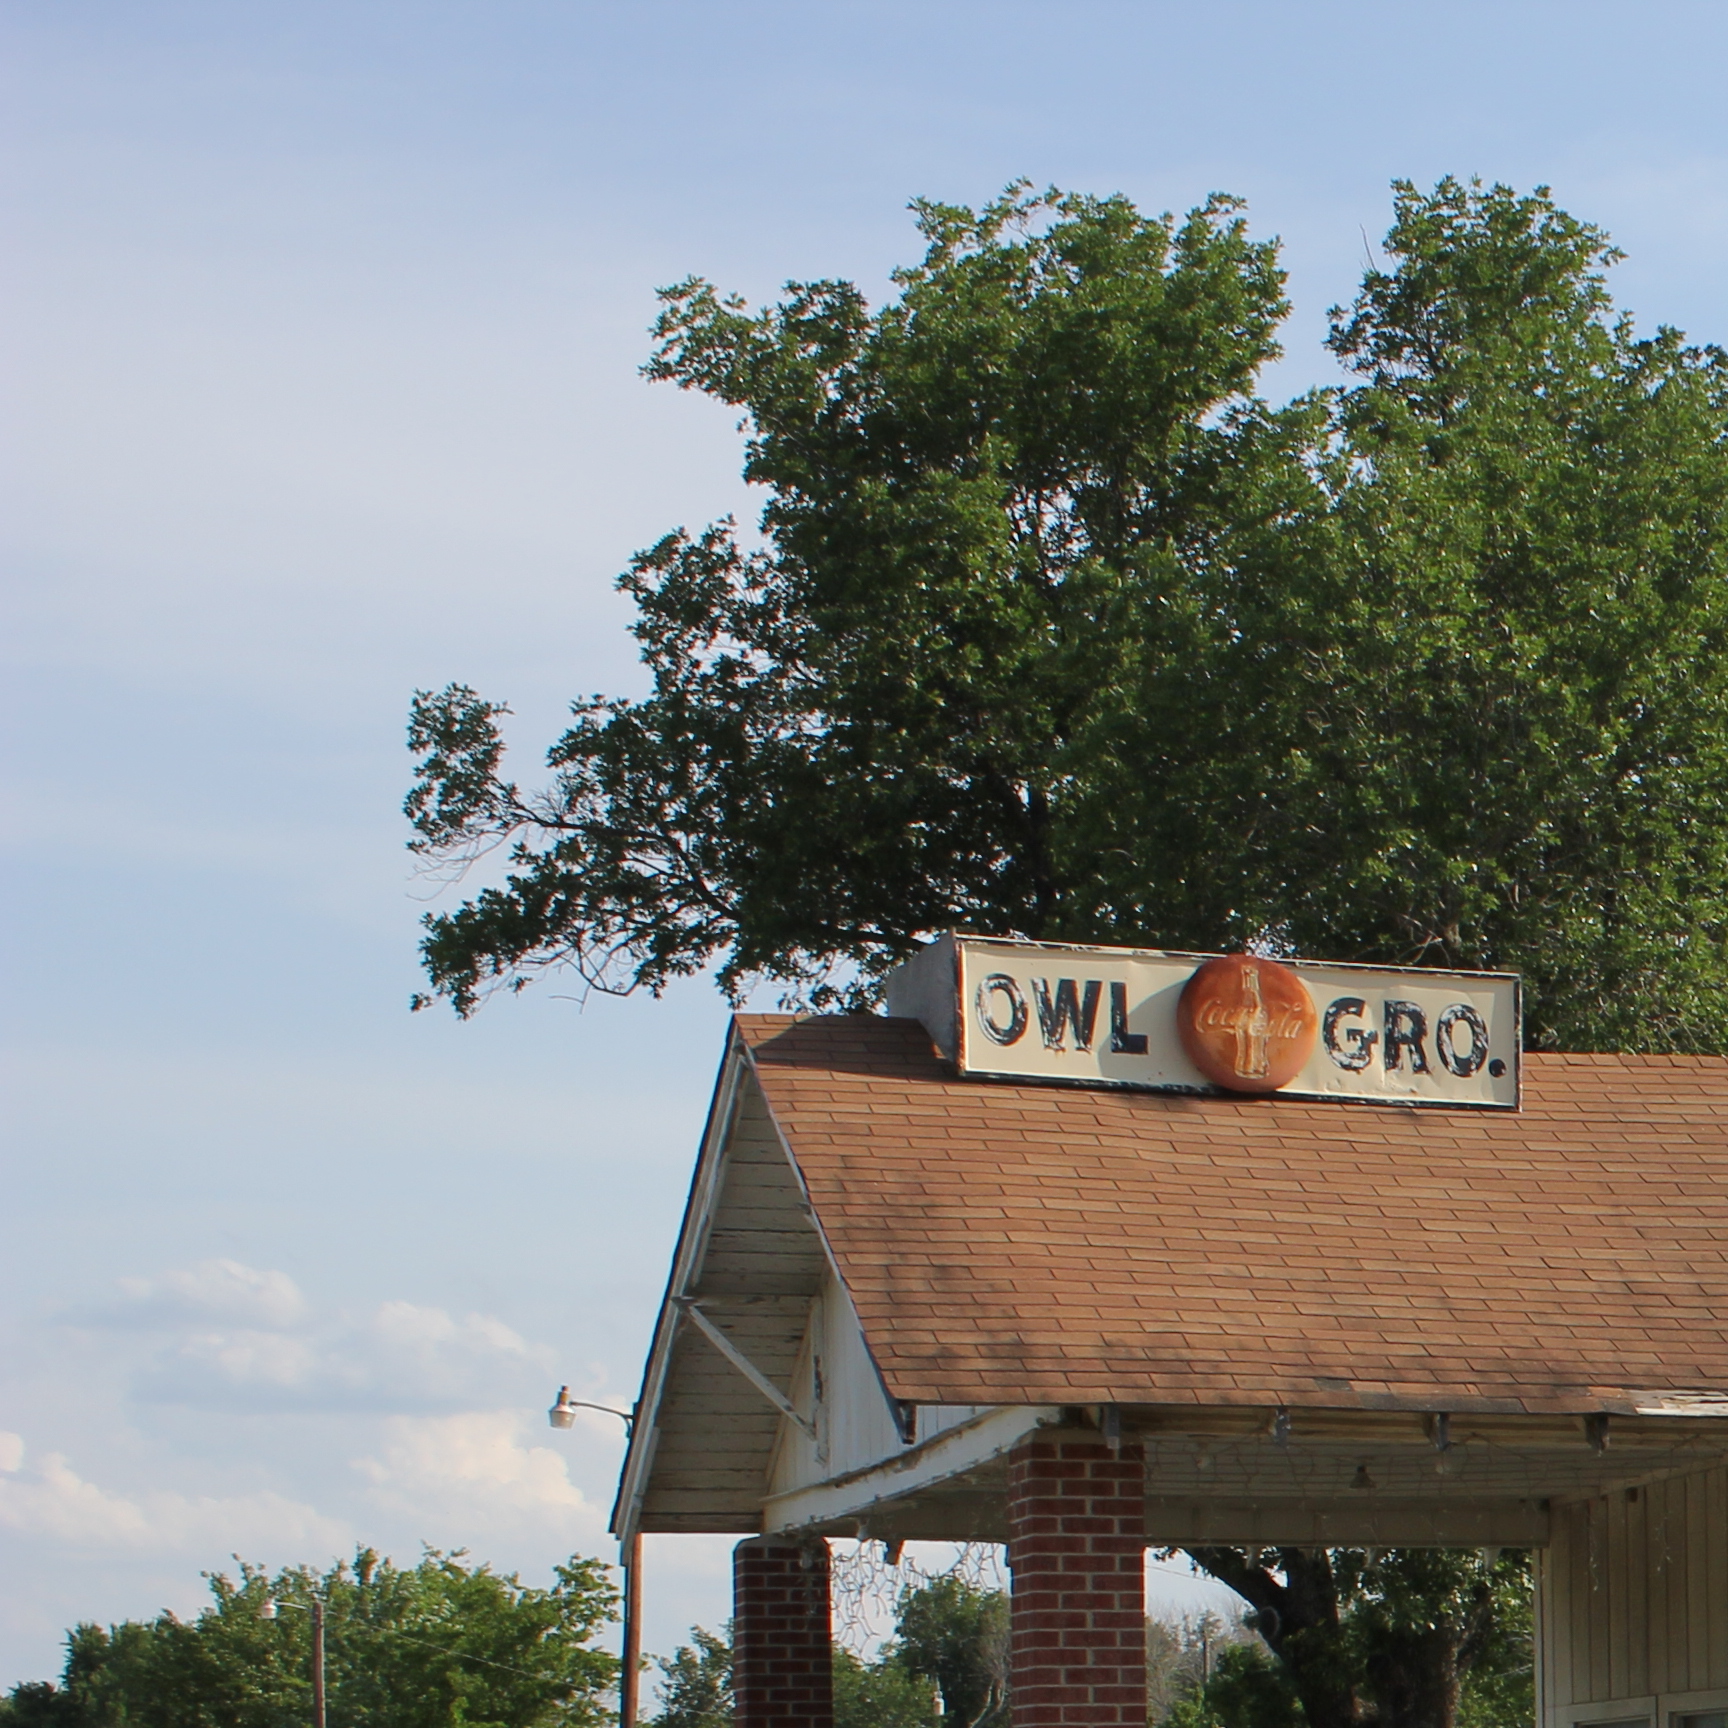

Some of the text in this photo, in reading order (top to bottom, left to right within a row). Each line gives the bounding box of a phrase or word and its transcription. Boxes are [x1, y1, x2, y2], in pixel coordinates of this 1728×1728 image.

[975, 972, 1508, 1078] OWL GRO.
[1195, 999, 1304, 1040] CocaCola
